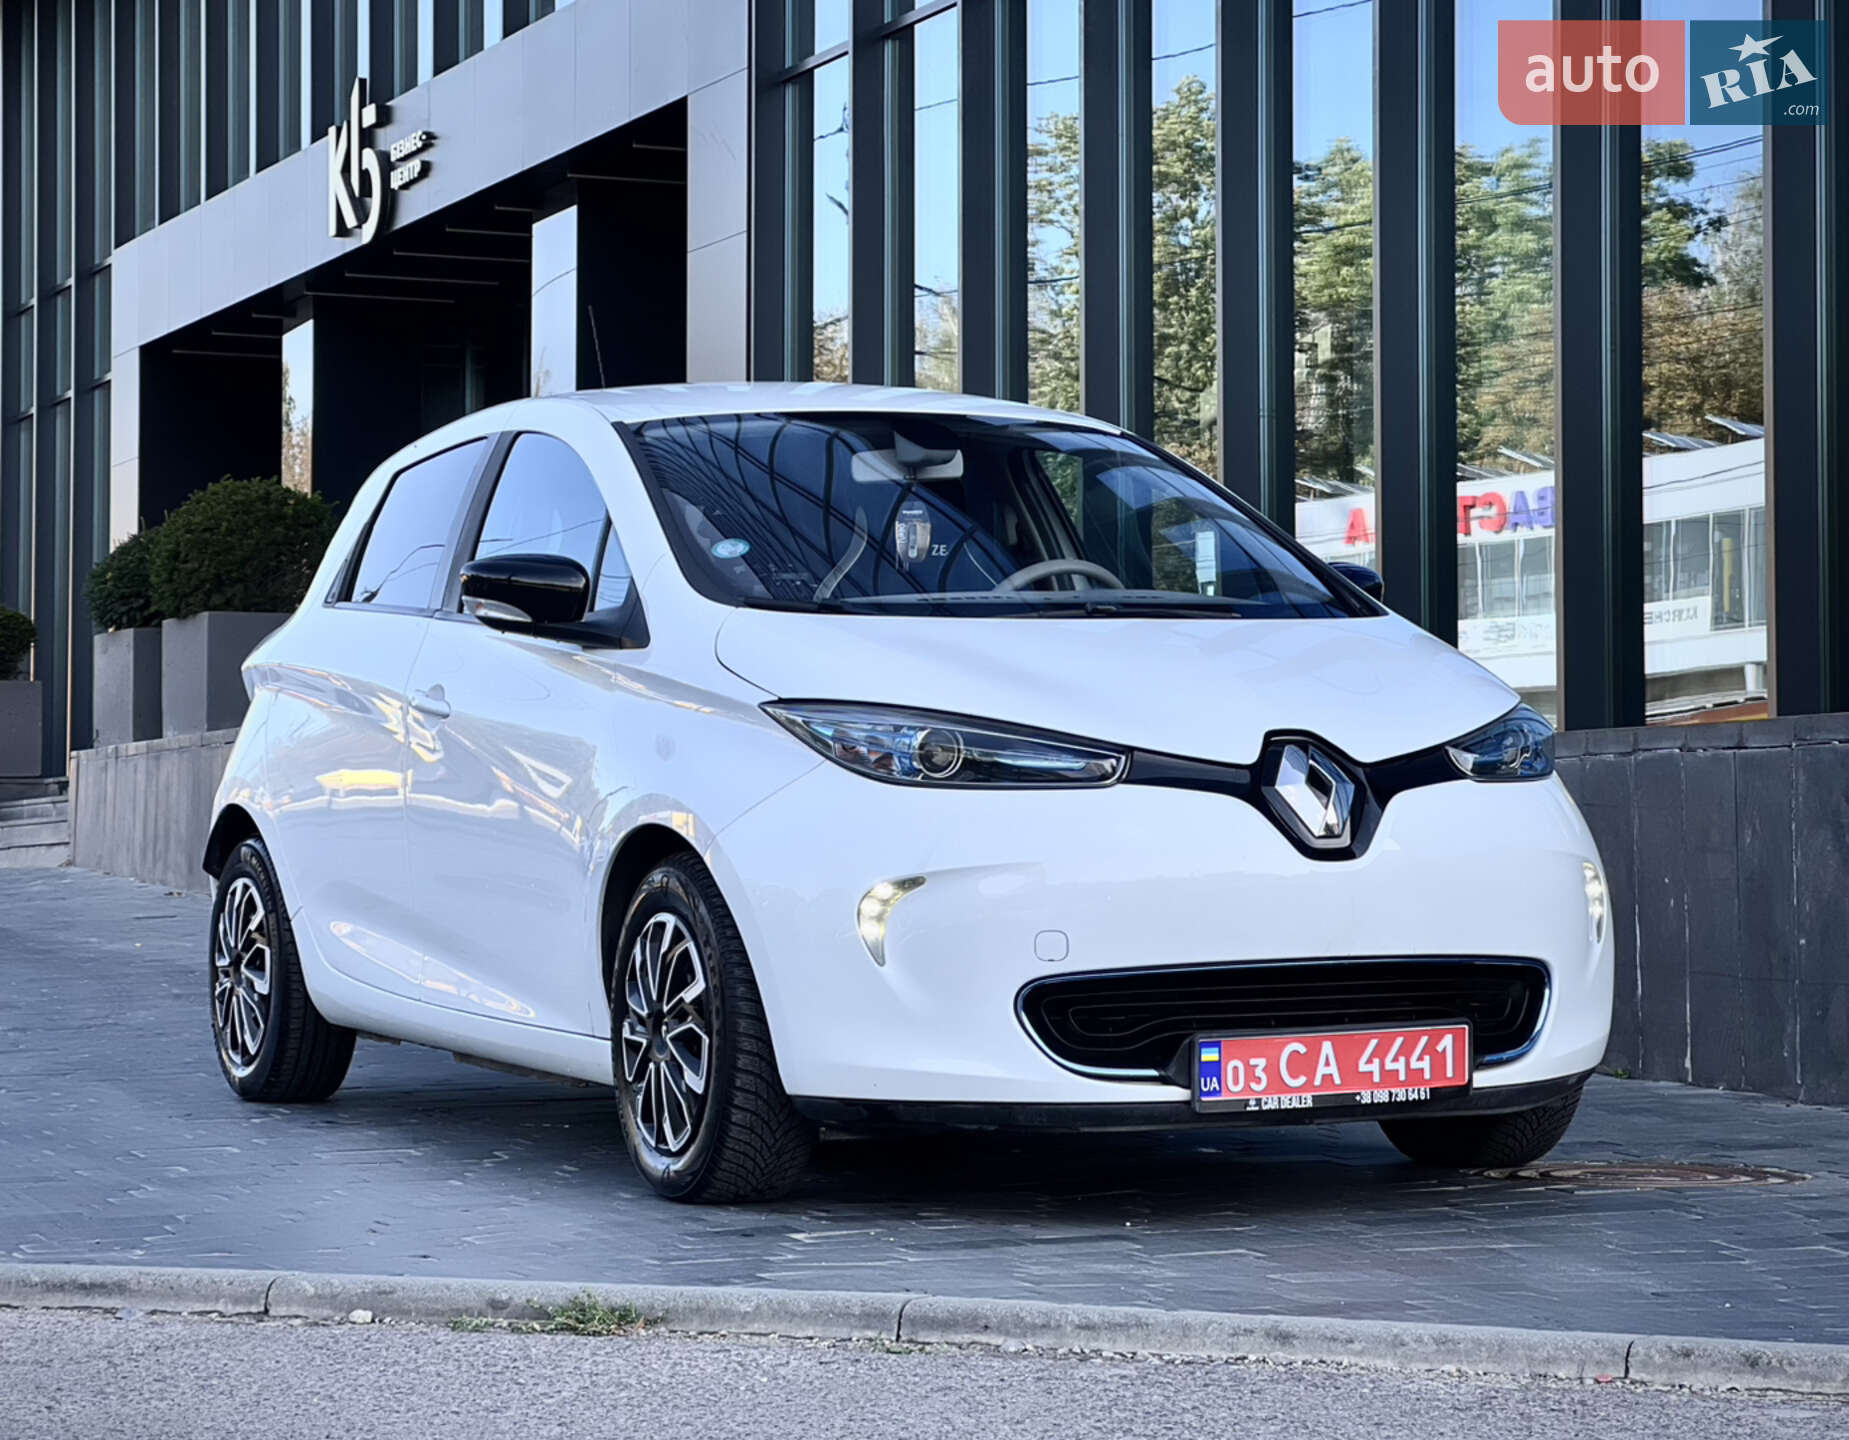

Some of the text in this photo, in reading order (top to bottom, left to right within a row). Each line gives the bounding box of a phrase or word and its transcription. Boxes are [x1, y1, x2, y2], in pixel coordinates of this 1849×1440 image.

[390, 159, 421, 191] ЦЕНТР
[1226, 1033, 1454, 1093] 03 CA 4441
[1201, 1077, 1220, 1092] UA
[1261, 1094, 1313, 1110] CAR DEALER
